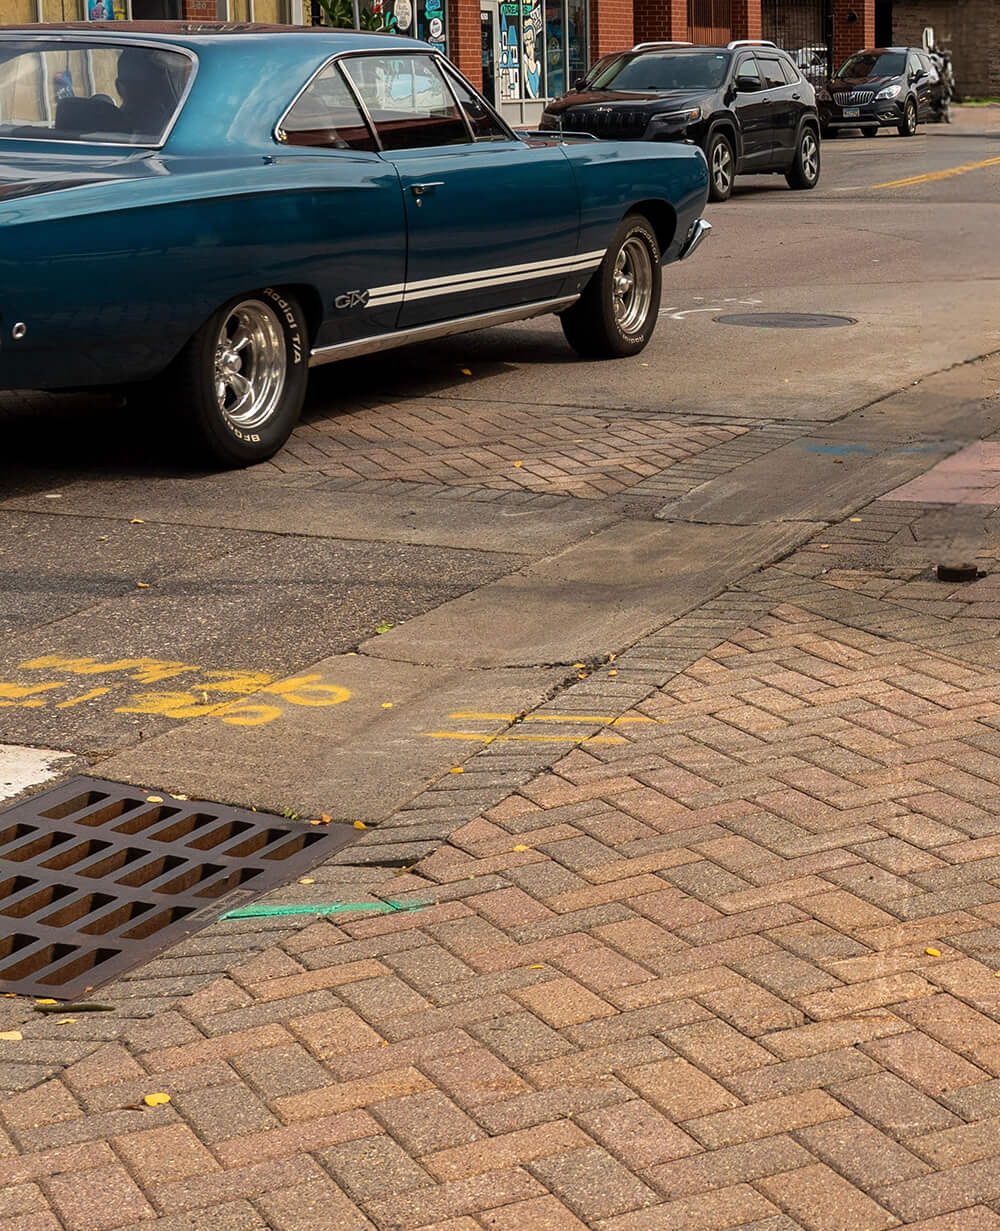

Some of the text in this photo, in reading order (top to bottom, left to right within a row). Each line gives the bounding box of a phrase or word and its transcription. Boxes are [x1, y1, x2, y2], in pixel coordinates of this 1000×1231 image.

[335, 290, 368, 308] GTX
[264, 288, 302, 364] Radial T/A
